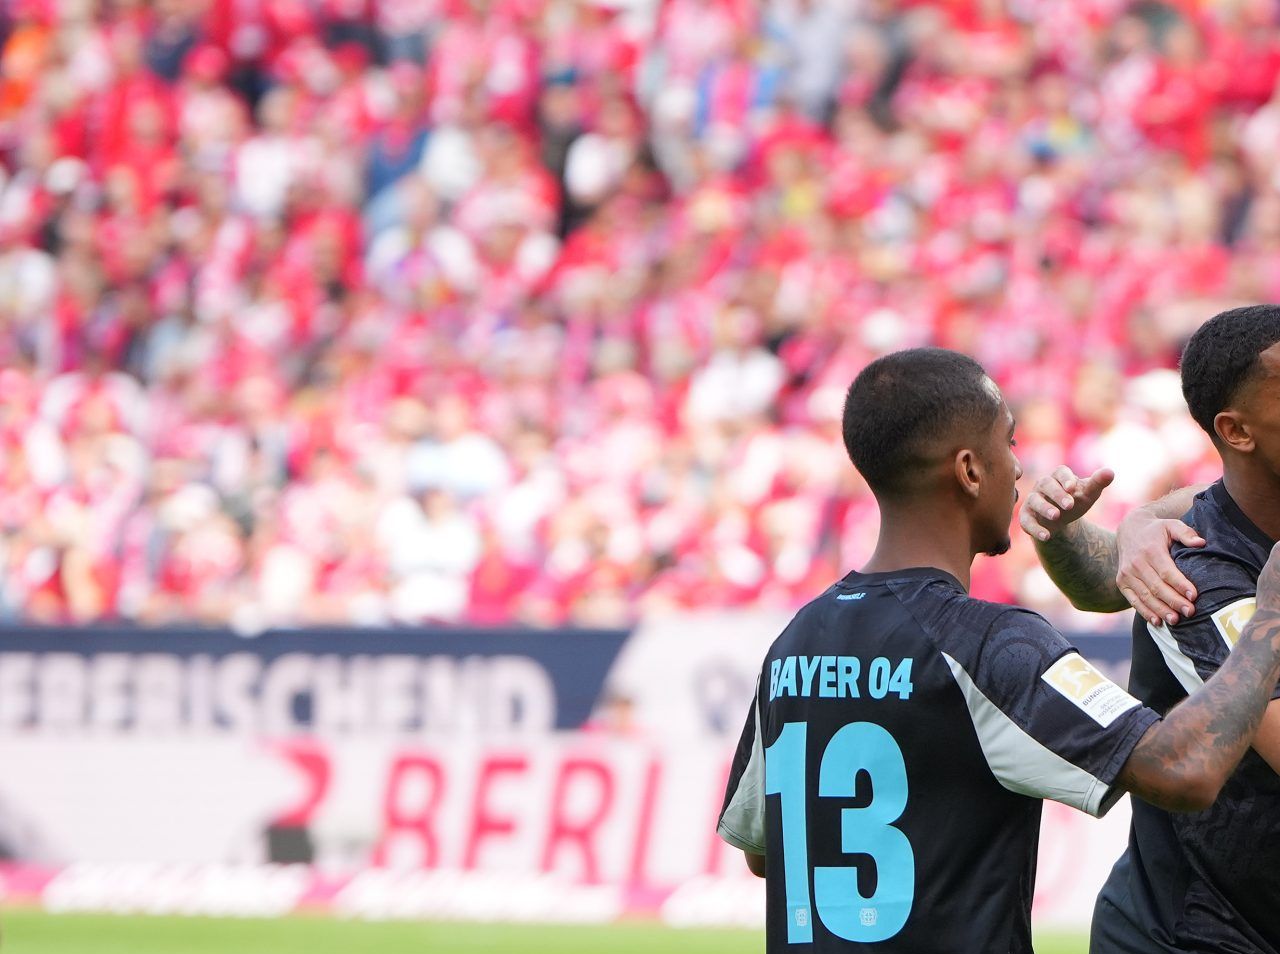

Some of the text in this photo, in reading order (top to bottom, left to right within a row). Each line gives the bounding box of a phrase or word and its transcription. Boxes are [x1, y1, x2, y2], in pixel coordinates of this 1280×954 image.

[769, 655, 914, 702] BAYER 04
[764, 721, 915, 944] 13
